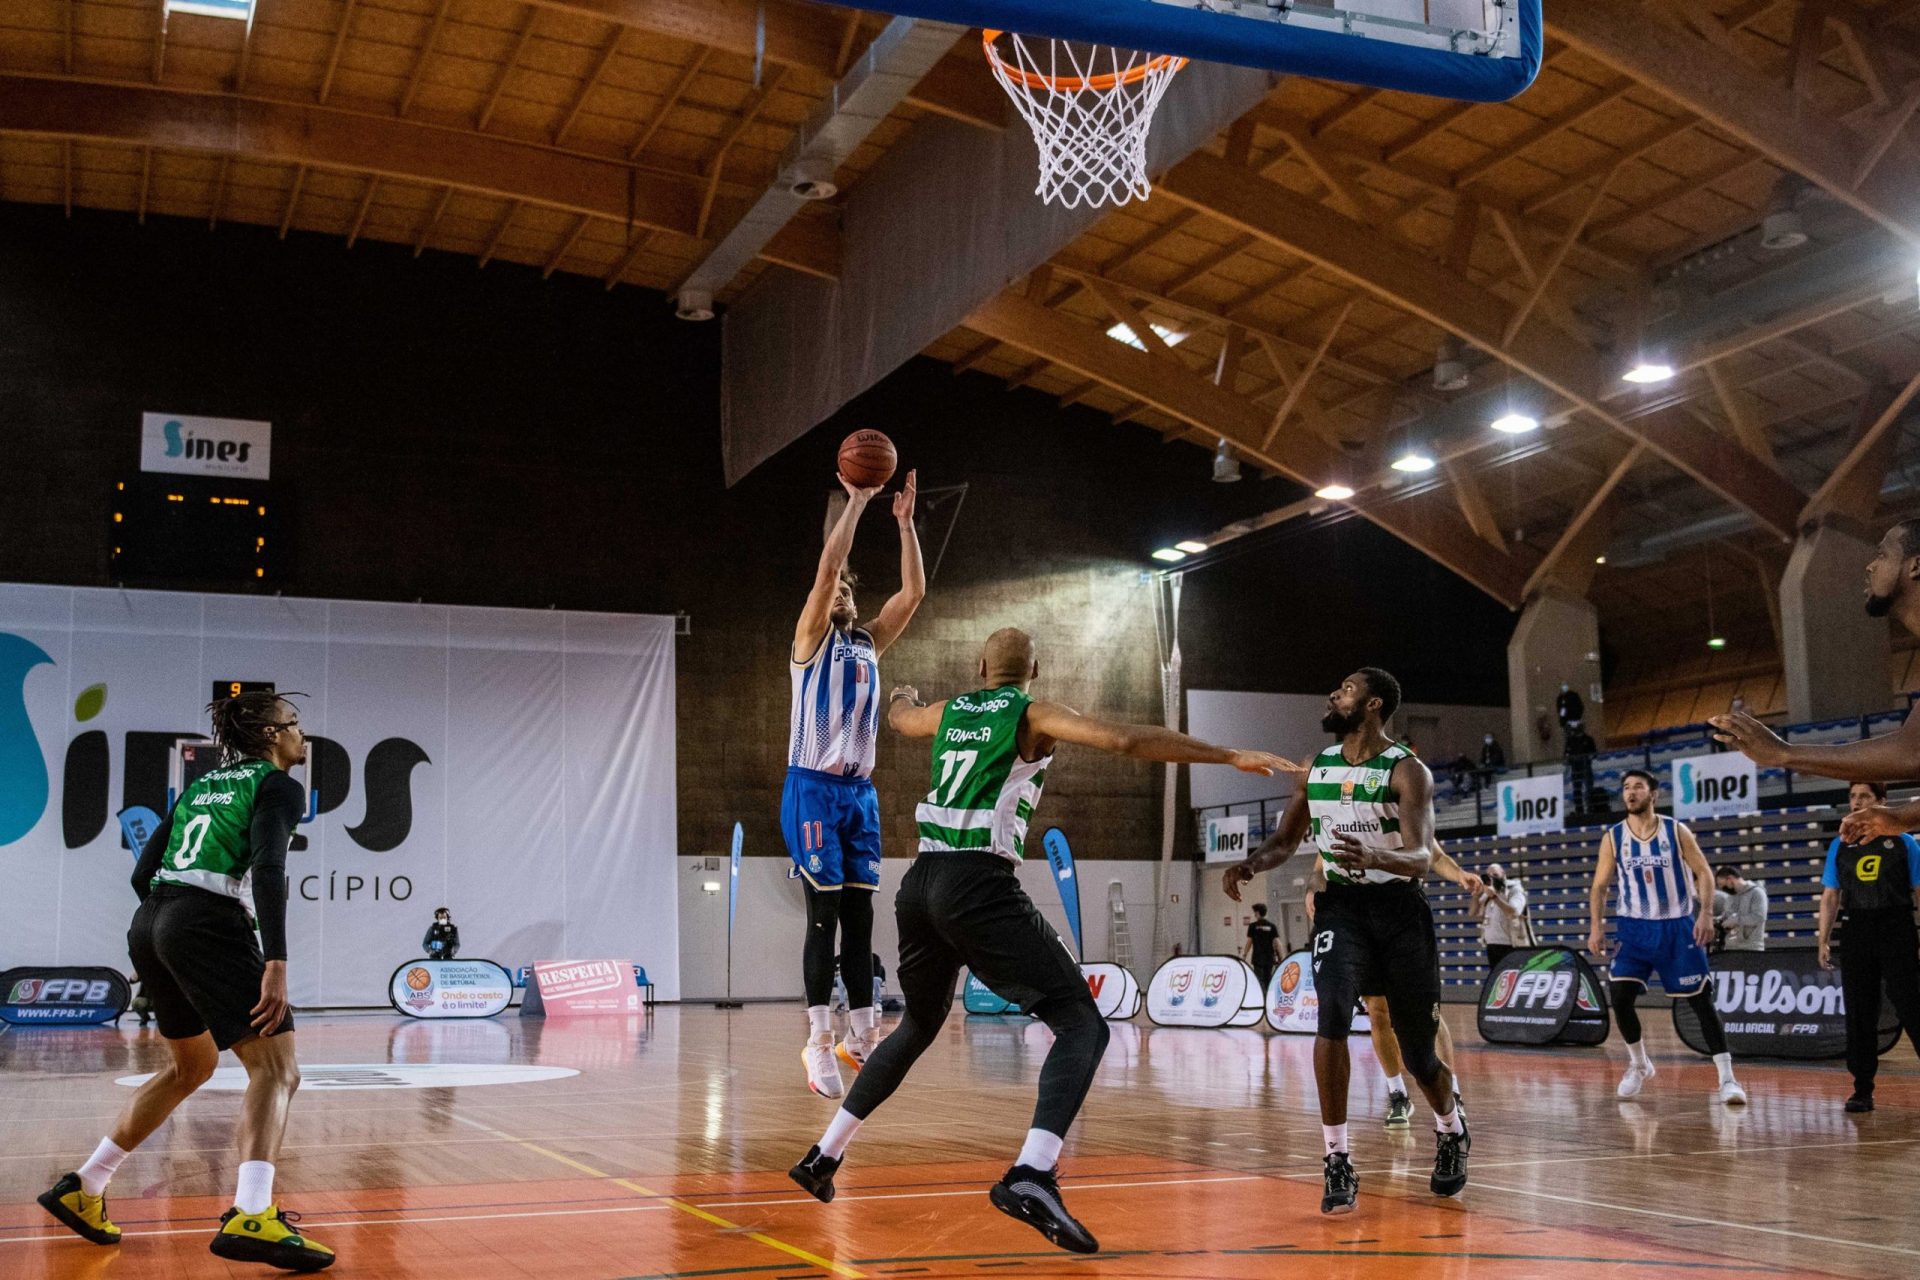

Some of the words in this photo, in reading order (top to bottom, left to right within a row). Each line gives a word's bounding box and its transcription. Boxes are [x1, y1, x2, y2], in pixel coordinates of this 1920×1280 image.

[164, 421, 251, 462] Sines
[856, 663, 869, 684] 11
[230, 682, 241, 698] 9
[927, 749, 979, 807] 17
[1679, 762, 1749, 805] Sines
[1502, 785, 1558, 823] Sines
[803, 821, 823, 851] 11
[1209, 822, 1245, 852] Sines
[1336, 821, 1379, 833] auditiv
[173, 813, 213, 870] 0
[1862, 858, 1876, 873] G
[1313, 930, 1335, 958] 13
[538, 961, 613, 986] RESPEITA
[39, 980, 111, 1001] FPB
[410, 992, 432, 1000] ABS
[441, 992, 468, 1000] Onde
[477, 992, 504, 1000] cesto
[1507, 970, 1572, 1009] FPB
[1709, 969, 1847, 1015] Wilson
[17, 1009, 96, 1018] WWW.FPB.PT
[441, 1001, 449, 1010] é
[457, 1001, 488, 1009] limite!
[1724, 1022, 1744, 1033] BOLA
[1745, 1023, 1775, 1034] OFICIAL
[1791, 1023, 1819, 1034] FPB
